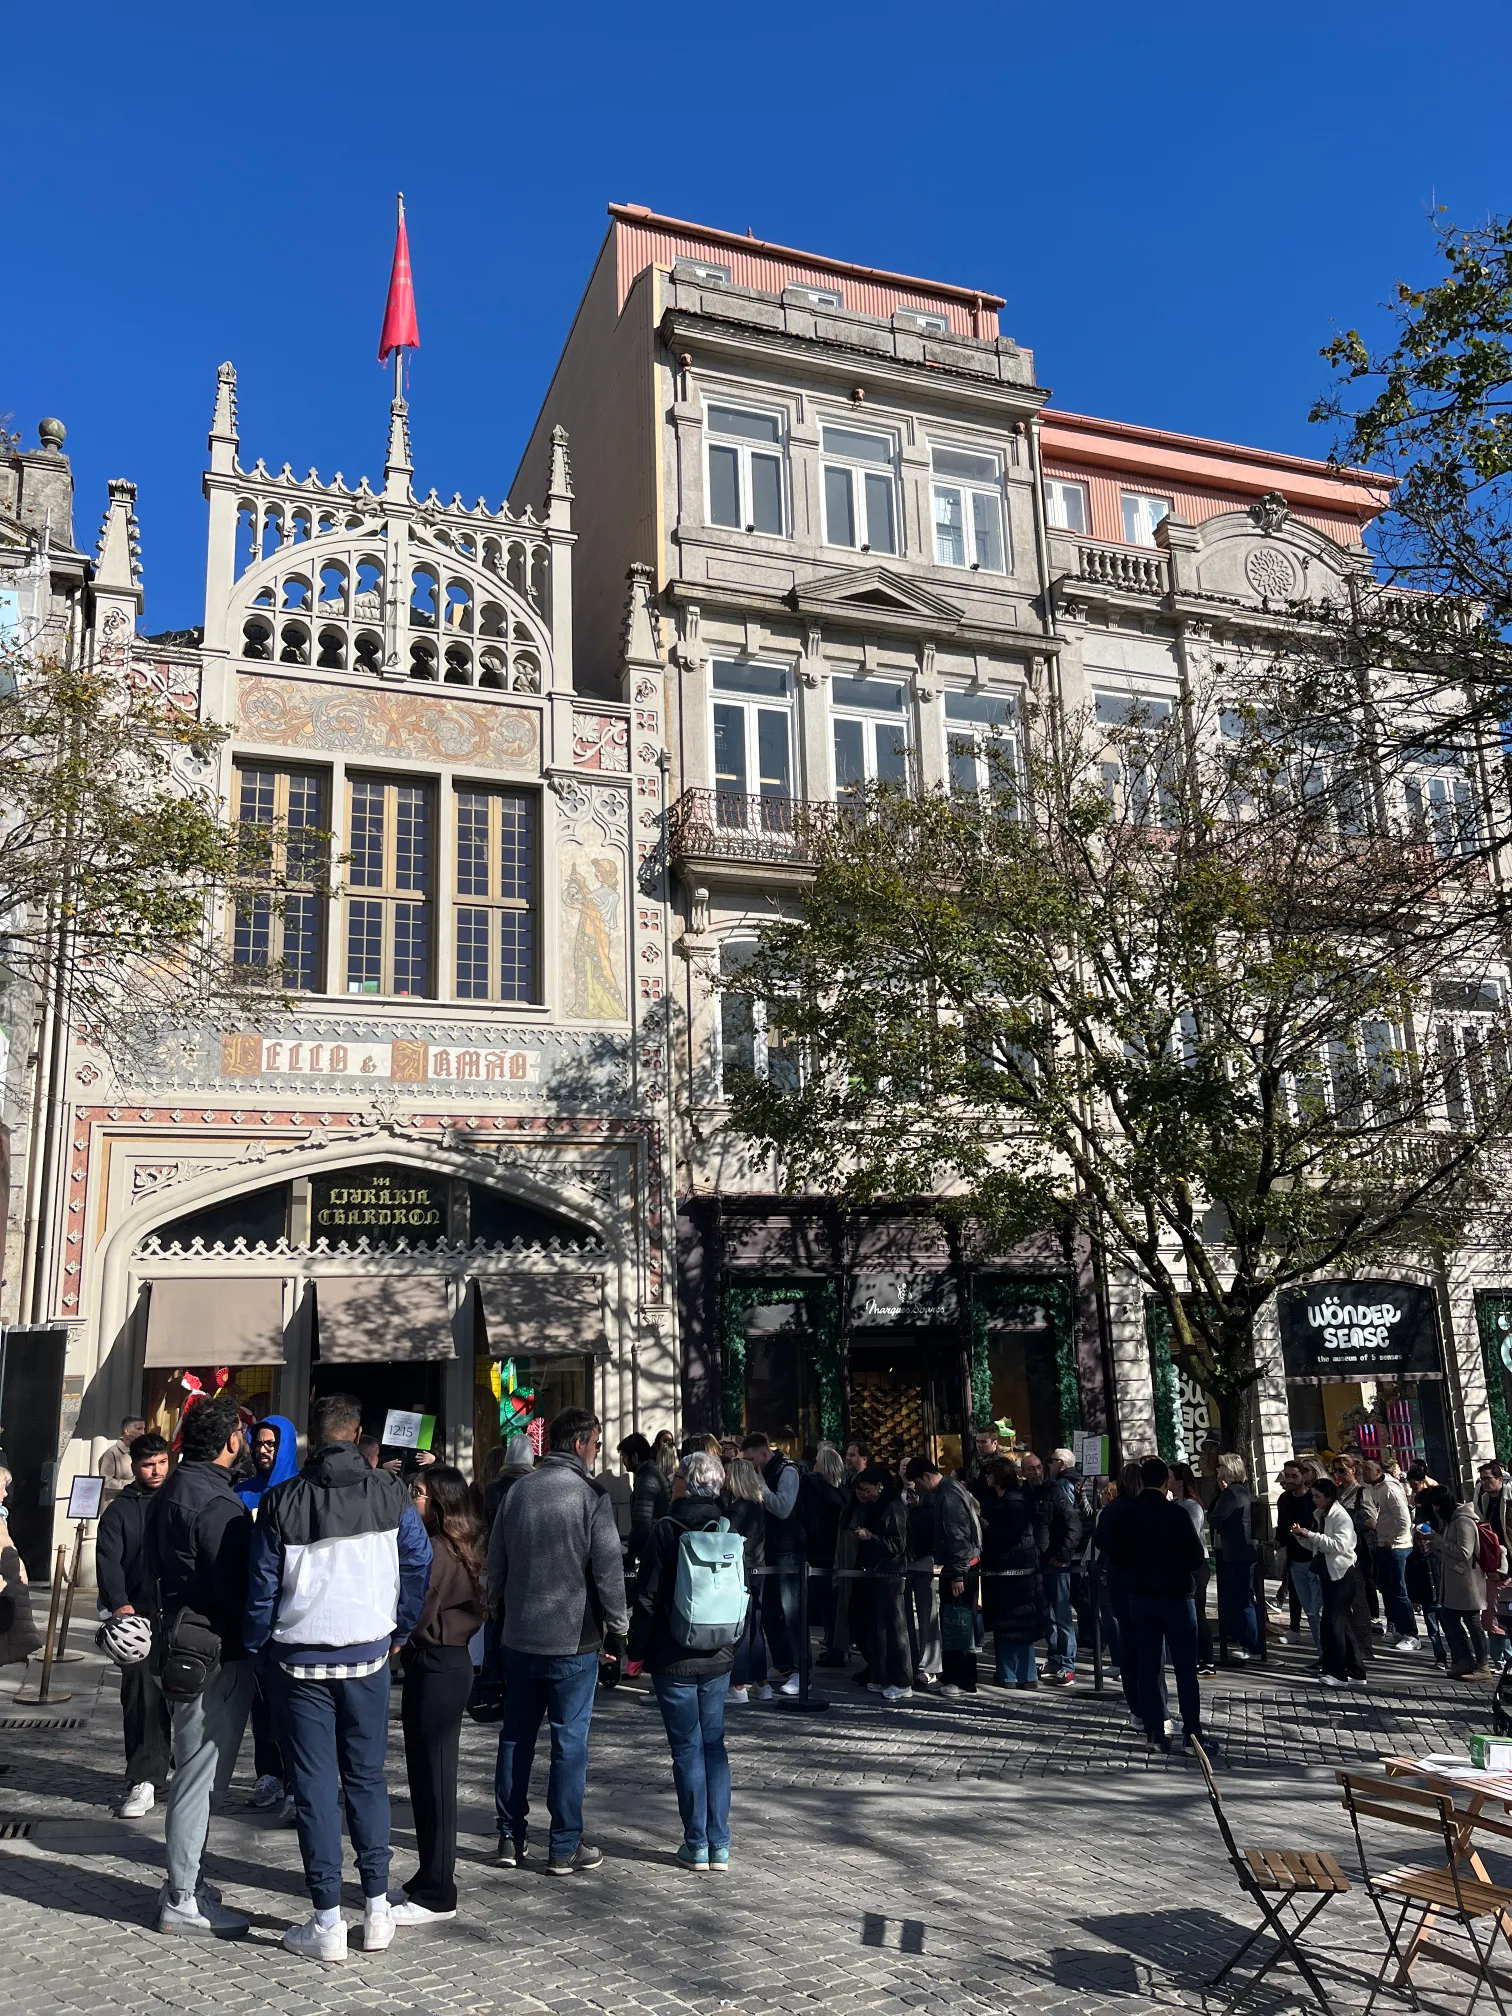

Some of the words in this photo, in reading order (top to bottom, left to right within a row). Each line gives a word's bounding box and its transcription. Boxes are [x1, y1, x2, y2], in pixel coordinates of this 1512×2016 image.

[359, 1054, 378, 1074] &
[372, 1177, 391, 1186] 144
[330, 1188, 431, 1205] LIVRARIA
[317, 1208, 440, 1226] CHARDRON
[866, 1298, 910, 1317] Marques
[1317, 1355, 1330, 1363] the
[1359, 1353, 1369, 1361] of
[1371, 1353, 1377, 1361] 5
